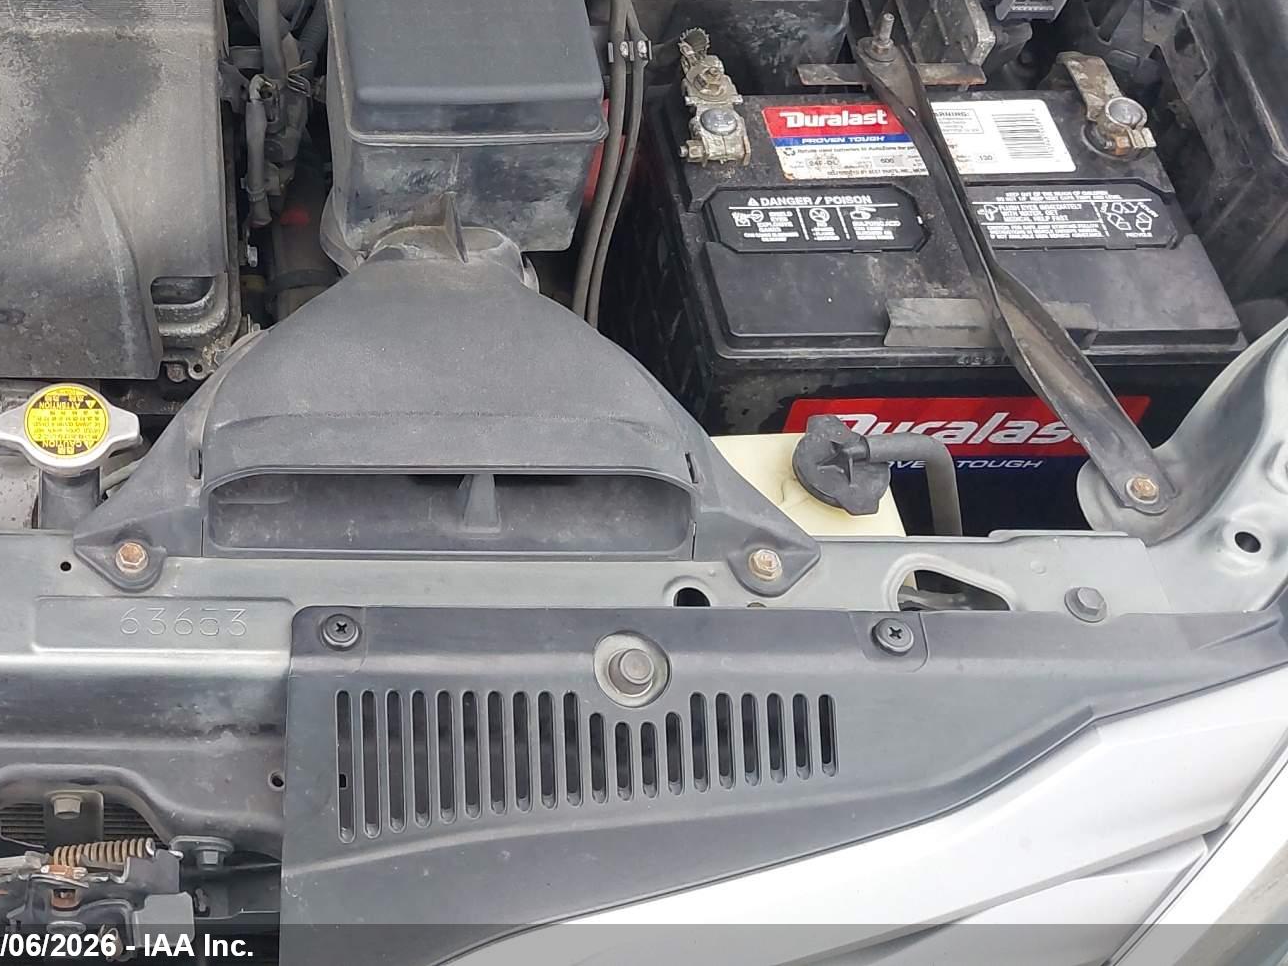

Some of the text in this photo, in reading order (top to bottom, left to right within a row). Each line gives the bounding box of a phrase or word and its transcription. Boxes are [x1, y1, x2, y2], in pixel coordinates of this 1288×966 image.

[779, 109, 889, 128] Duralast
[801, 135, 886, 145] PROVEN TOUGH
[762, 195, 873, 206] DANGER / POISON
[40, 401, 81, 410] ATTENTION
[42, 440, 83, 448] CAUTION
[956, 460, 1045, 469] TOUGH
